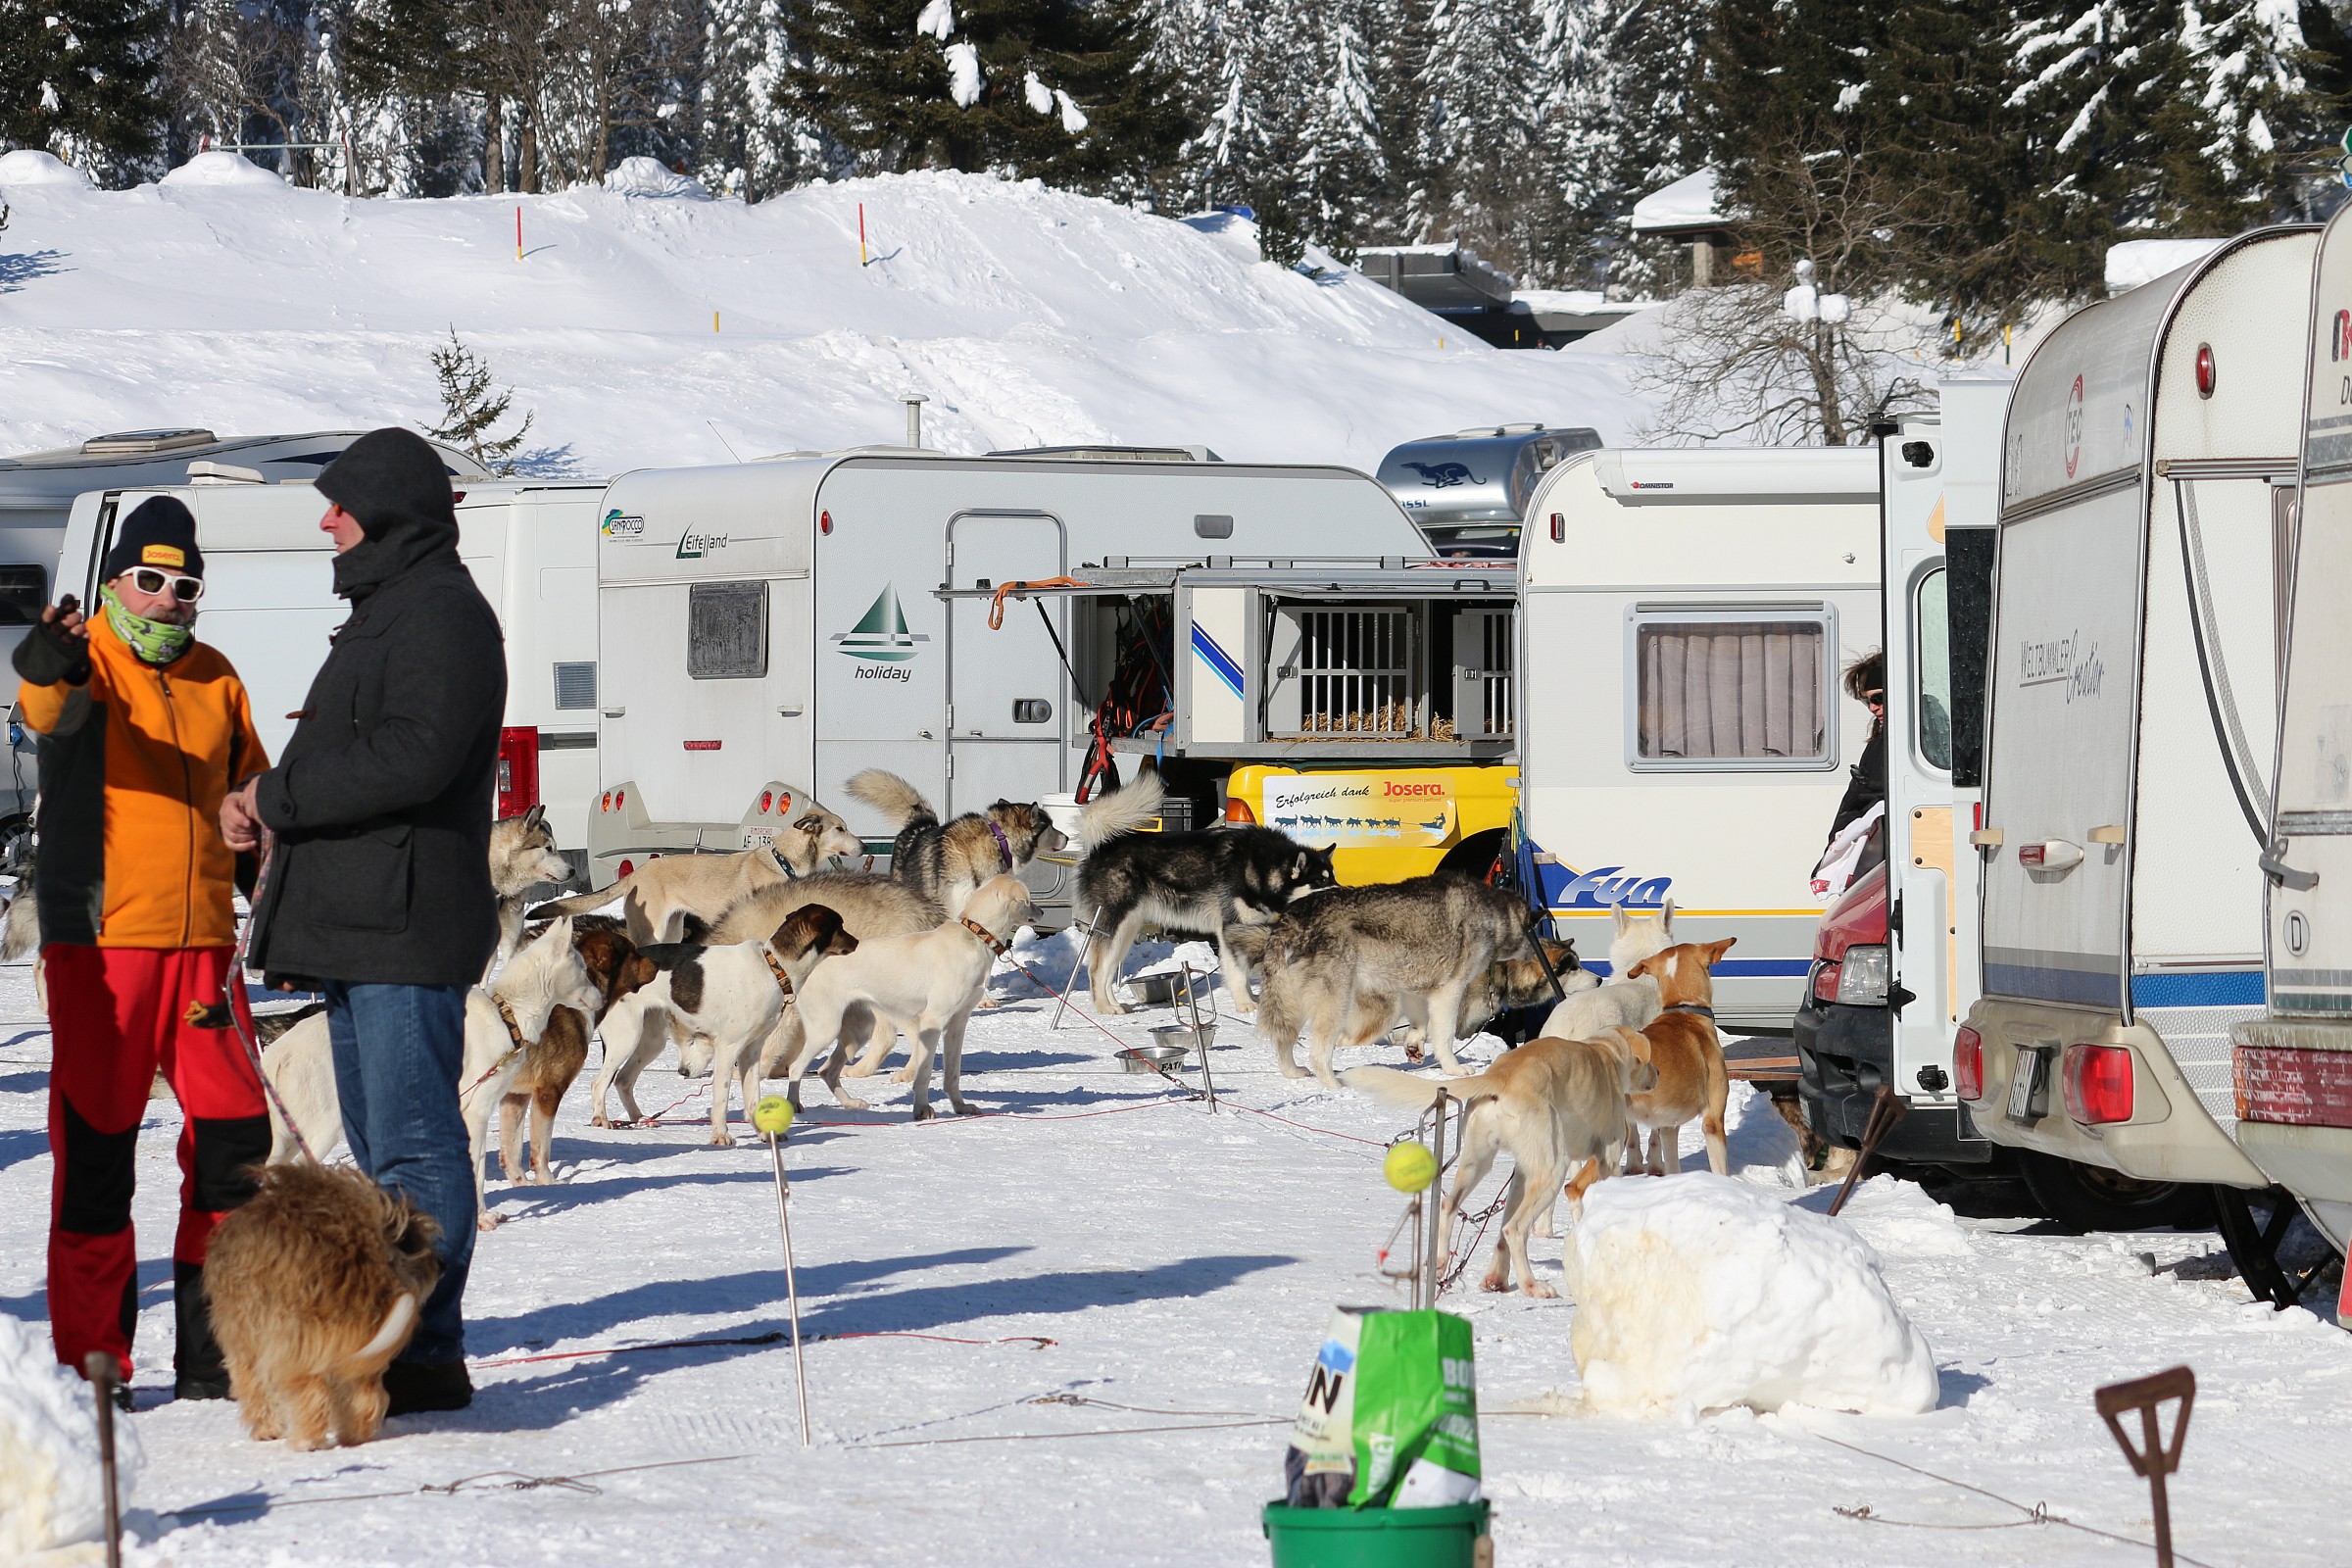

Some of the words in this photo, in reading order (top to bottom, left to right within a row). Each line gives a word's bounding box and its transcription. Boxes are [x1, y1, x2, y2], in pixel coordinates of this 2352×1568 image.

[855, 665, 911, 683] holiday
[1275, 787, 1337, 808] Erfolgreich
[1341, 785, 1370, 797] dank
[2291, 916, 2302, 951] D
